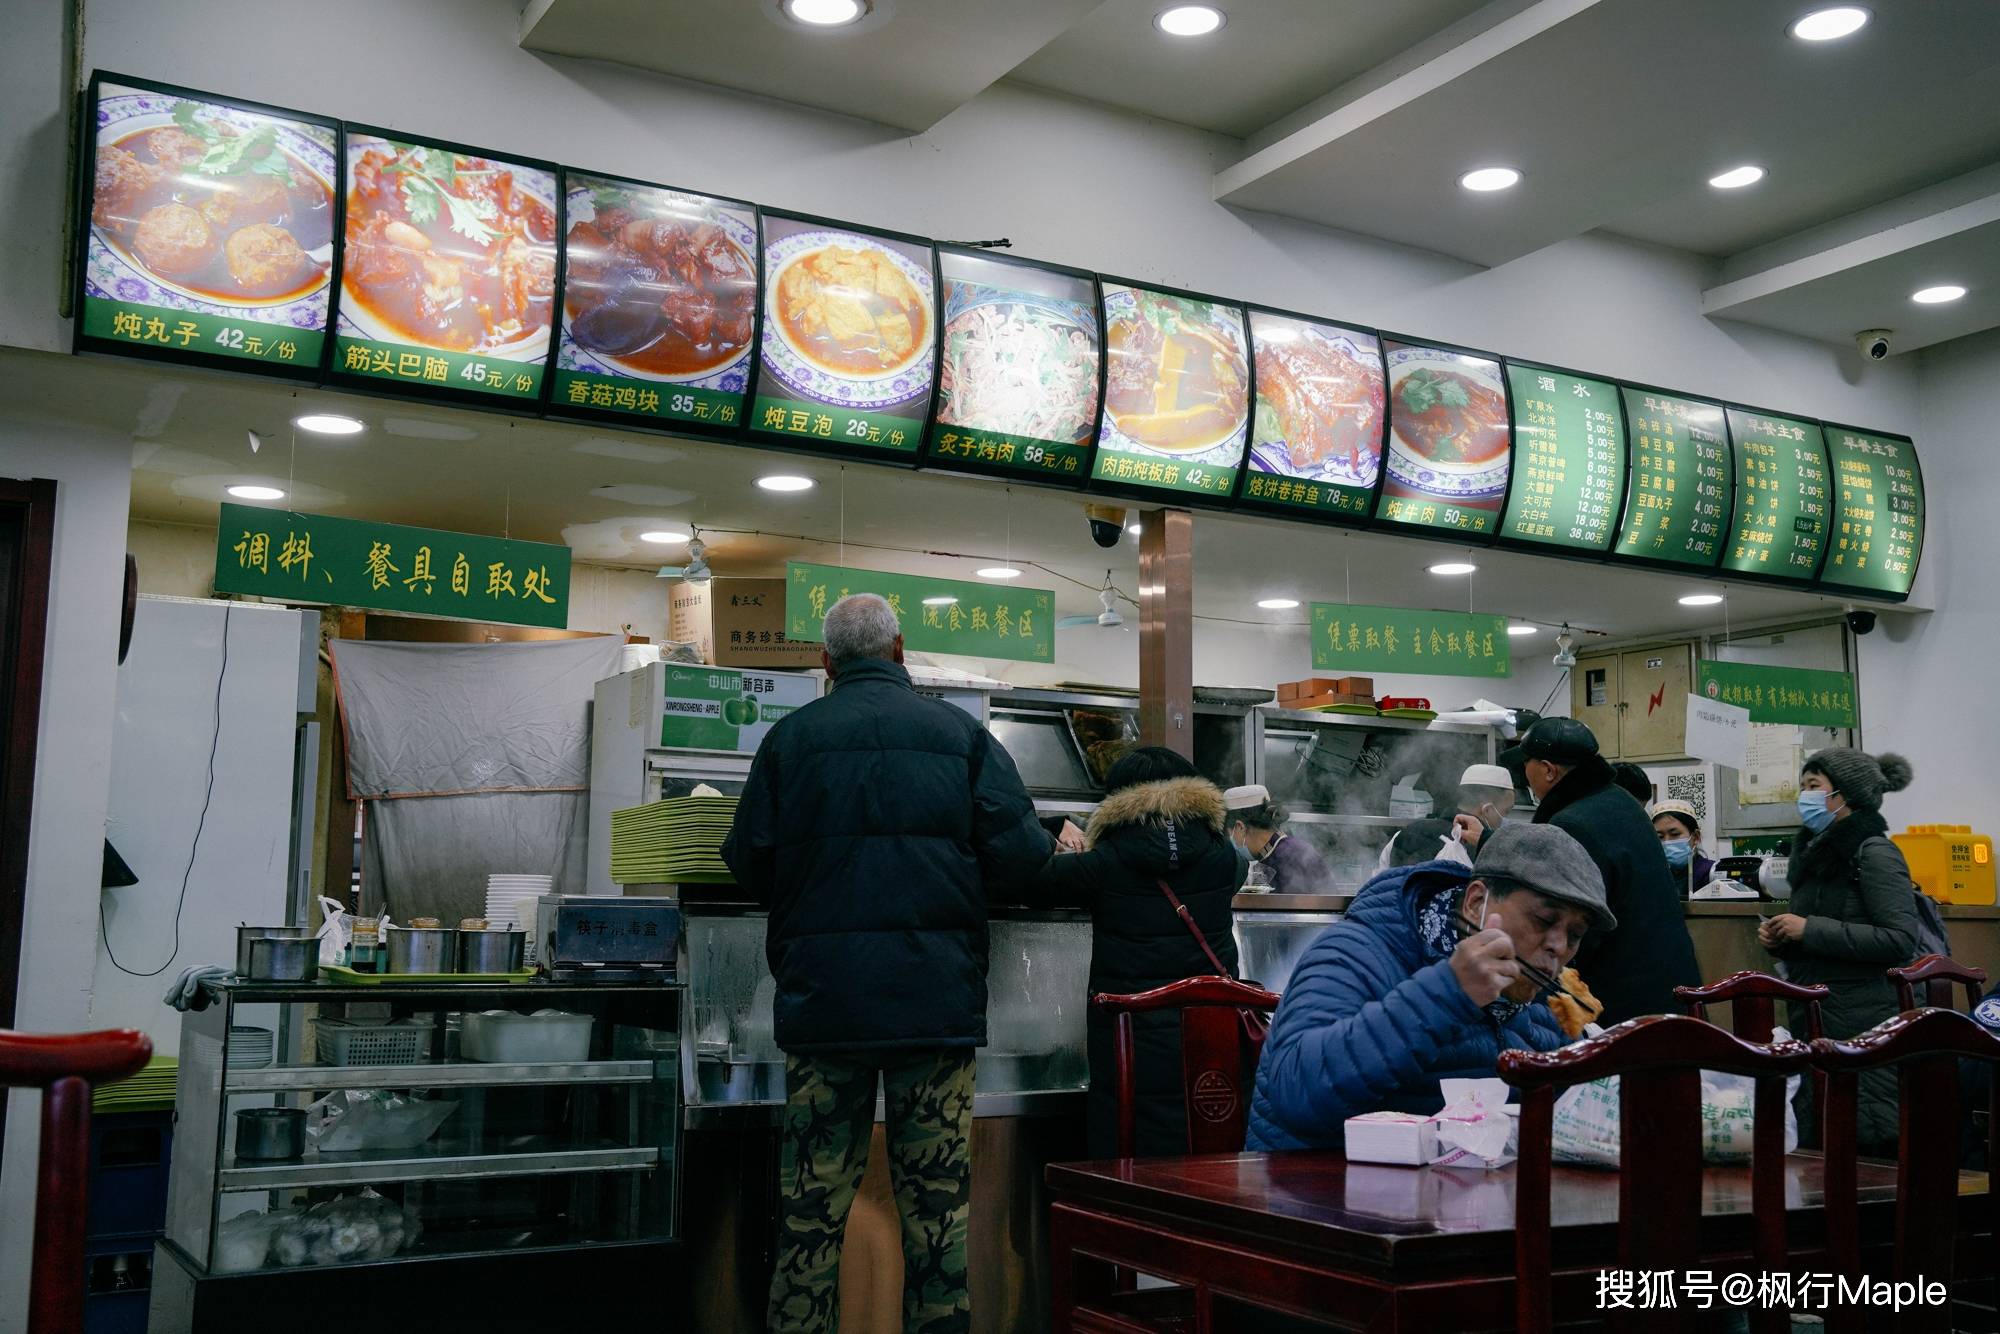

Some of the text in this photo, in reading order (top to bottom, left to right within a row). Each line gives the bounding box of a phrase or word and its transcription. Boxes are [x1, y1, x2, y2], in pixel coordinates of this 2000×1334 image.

[113, 312, 297, 360] 炖丸子 42元/份
[345, 345, 533, 392] 筋头巴脑 45元/份
[1538, 376, 1591, 398] 酒水
[568, 380, 736, 422] 香菇鸡块 35元/份
[1526, 399, 1555, 413] 矿泉水
[765, 406, 905, 445] 炖豆泡 26元/份
[1529, 412, 1556, 426] 北冰洋
[940, 433, 1078, 471] 炙子烤肉 58元/份
[1844, 436, 1898, 458] 早餐主食
[1101, 456, 1229, 491] 肉筋炖板筋 42元/份
[1640, 474, 1675, 492] 豆腐脑
[1249, 476, 1365, 510] 烙饼卷带鱼 78元/份
[1523, 495, 1552, 509] 大可乐
[1386, 500, 1485, 530] 炖牛肉 50元/份
[1520, 509, 1549, 523] 大白牛
[1628, 531, 1665, 549] 豆汁
[1327, 620, 1400, 655] 凭票取餐
[576, 920, 659, 937] 筷子消毒盒
